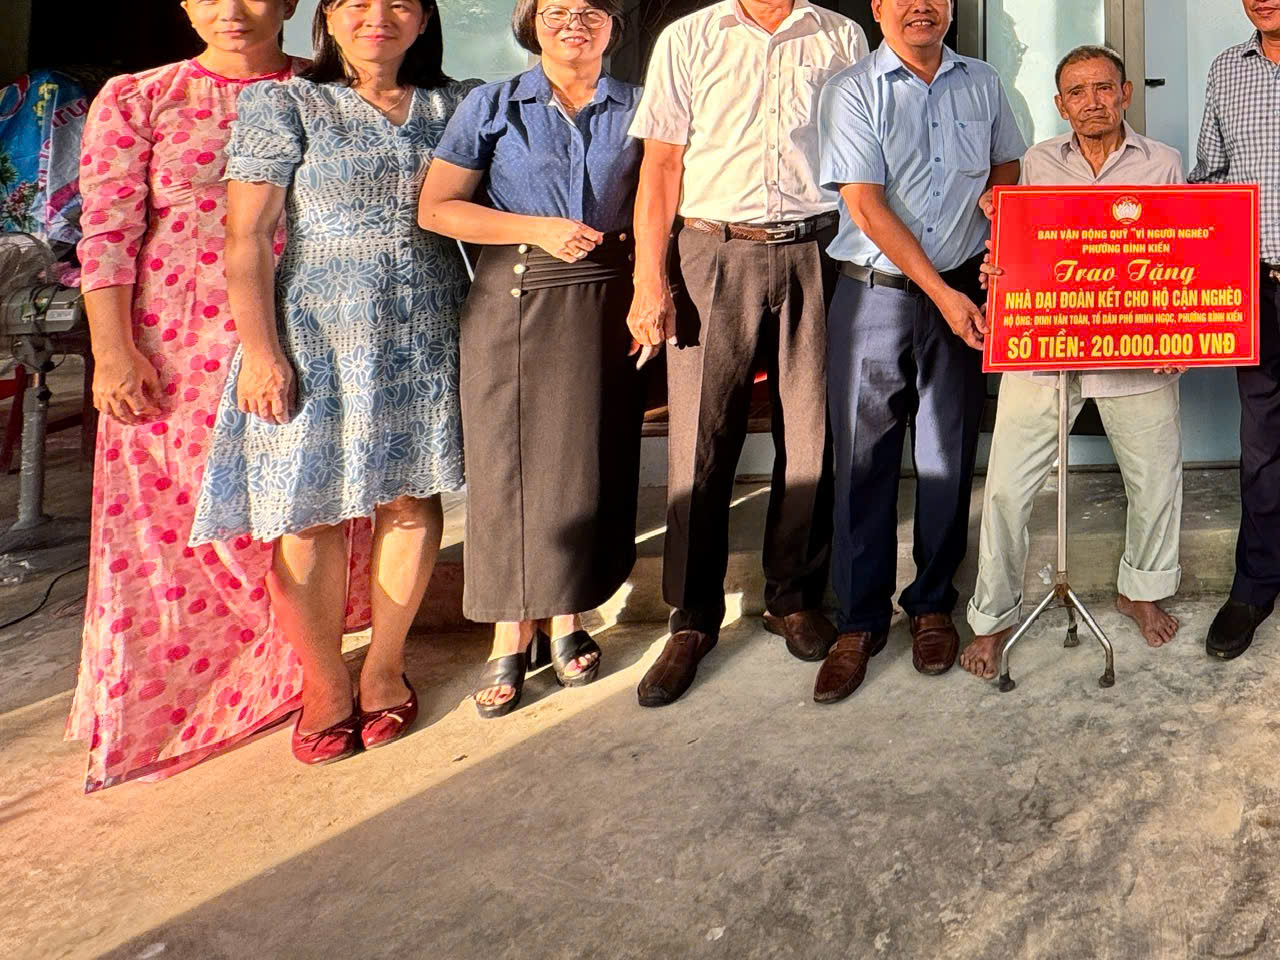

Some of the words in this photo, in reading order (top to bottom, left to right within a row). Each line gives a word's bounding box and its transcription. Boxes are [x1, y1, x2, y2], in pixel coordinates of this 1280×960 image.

[1037, 230, 1058, 240] BAN
[1060, 228, 1079, 242] VẬN
[1082, 242, 1120, 254] PHƯỜNG
[1123, 242, 1146, 254] BÌNH
[1148, 240, 1170, 254] KIẾN
[1054, 260, 1116, 282] Trao
[1128, 259, 1196, 286] Tặng
[1005, 288, 1032, 310] NHÀ
[1035, 292, 1056, 312] ĐẠI
[1060, 288, 1095, 308] ĐOÀN
[1098, 286, 1121, 308] KẾT
[1124, 290, 1149, 308] CHO
[1152, 286, 1169, 310] HỘ
[1172, 286, 1198, 310] CẬN
[1200, 286, 1242, 306] NGHÈO
[1008, 328, 1034, 359] SỐ
[1038, 328, 1084, 359] TIỀN:
[1091, 333, 1193, 358] 20.000.000
[1198, 332, 1236, 356] VNĐ
